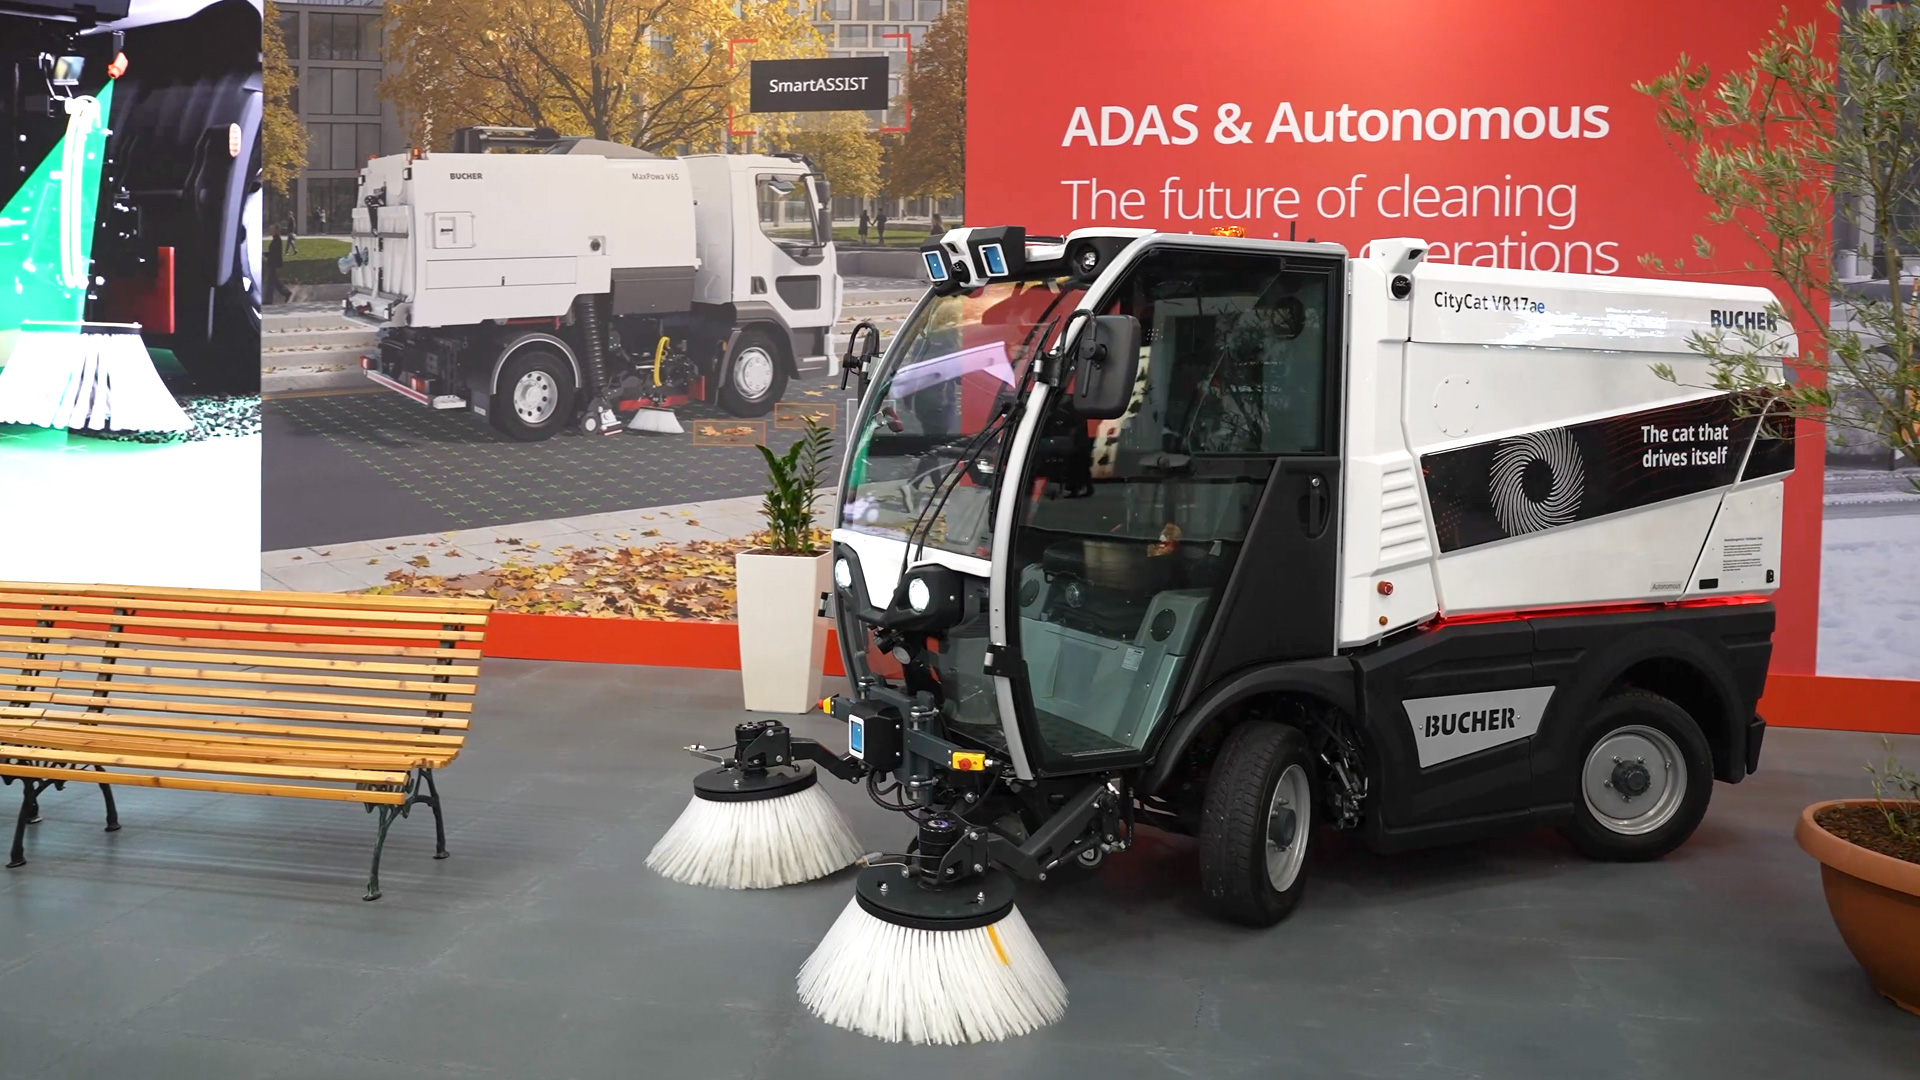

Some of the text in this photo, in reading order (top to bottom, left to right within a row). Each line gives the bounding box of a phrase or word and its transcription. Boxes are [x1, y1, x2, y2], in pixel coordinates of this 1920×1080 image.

[769, 77, 869, 93] SmartASSIST
[1061, 102, 1610, 147] ADAS & Autonomous
[449, 172, 483, 180] BUCHER
[631, 172, 665, 181] MaxPowa
[1060, 173, 1578, 231] The future of cleaning
[1359, 230, 1620, 275] erations
[1434, 291, 1545, 314] CityCat VR17ae
[1710, 309, 1778, 333] BUCHER
[1641, 422, 1729, 443] The cat that
[1642, 446, 1728, 468] drives itself
[1425, 707, 1515, 738] BUCHER
